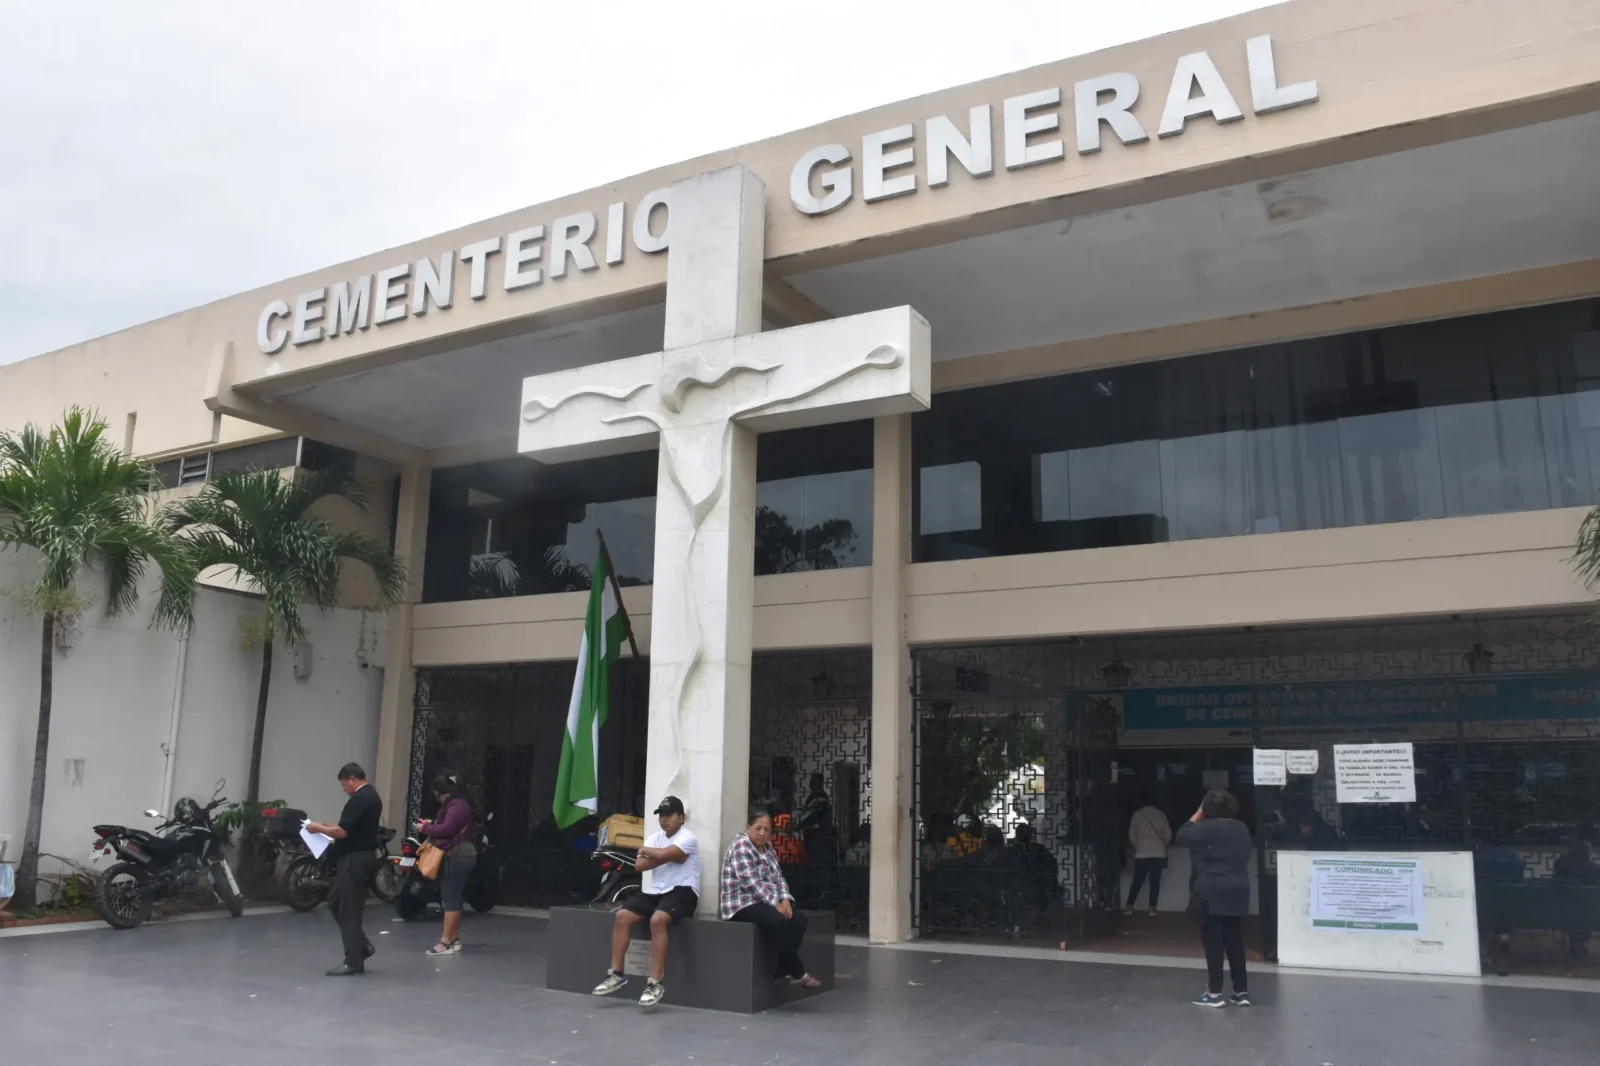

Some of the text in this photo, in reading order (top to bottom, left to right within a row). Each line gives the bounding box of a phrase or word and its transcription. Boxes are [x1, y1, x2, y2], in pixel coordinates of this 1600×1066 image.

[256, 34, 1320, 355] CEMENTERIO GENERAL
[1155, 693, 1218, 707] UNIDAD
[1185, 708, 1207, 720] DE
[1334, 866, 1394, 874] COMUNICADO
